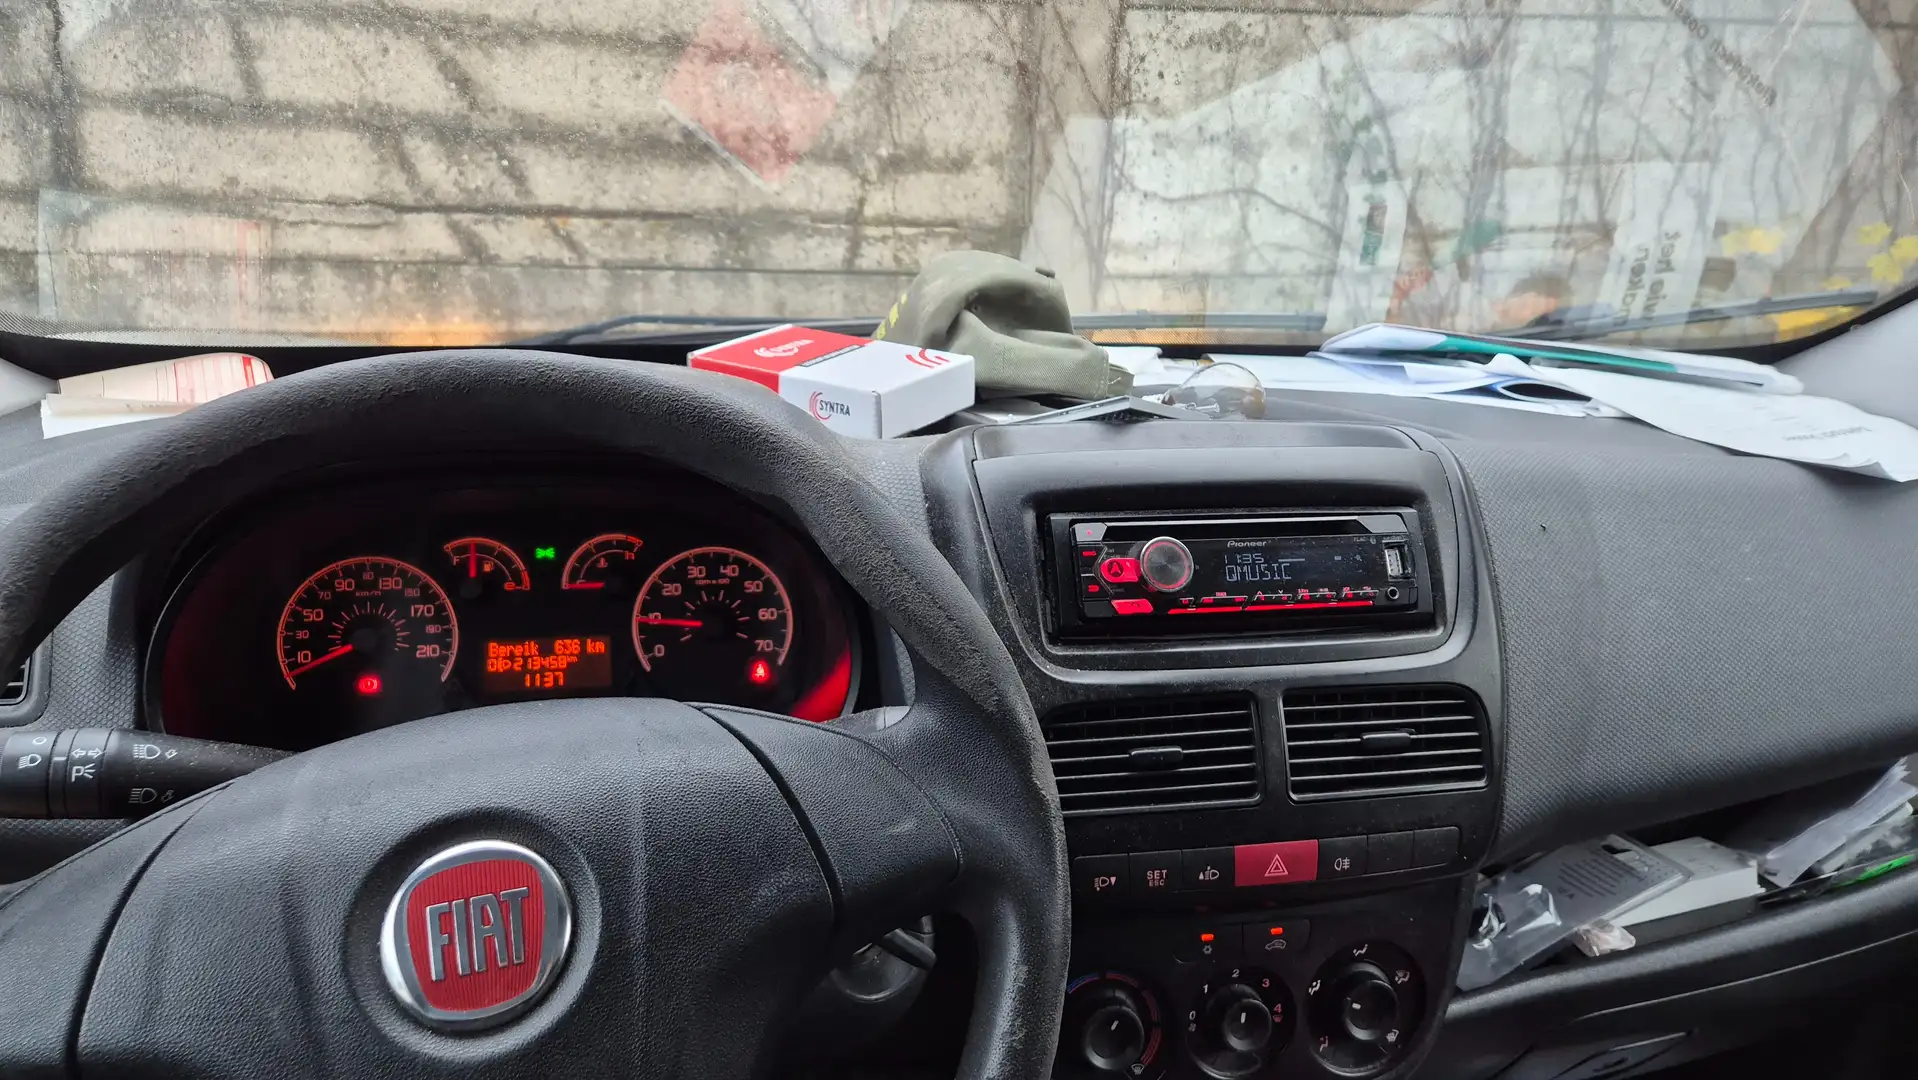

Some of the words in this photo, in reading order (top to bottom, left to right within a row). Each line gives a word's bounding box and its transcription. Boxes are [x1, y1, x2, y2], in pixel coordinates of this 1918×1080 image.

[819, 399, 851, 417] SYNTRA
[1227, 540, 1267, 548] Pioneer
[687, 566, 706, 578] 30
[720, 565, 739, 577] 40
[1225, 563, 1292, 582] QMUSIC
[335, 579, 356, 591] 90
[379, 577, 403, 590] 130
[662, 583, 682, 596] 20
[744, 580, 763, 593] 50
[320, 591, 332, 600] 70
[303, 609, 324, 622] 50
[411, 604, 435, 617] 170
[758, 608, 778, 620] 60
[296, 630, 309, 639] 30
[426, 625, 442, 634] 190
[416, 645, 440, 658] 210
[487, 641, 539, 657] Bereik
[586, 639, 605, 653] km
[654, 644, 665, 657] 0
[754, 639, 774, 652] 70
[297, 650, 311, 664] 10
[1146, 870, 1167, 880] SET
[1148, 879, 1165, 887] ESC
[425, 886, 529, 983] FIAT
[1231, 969, 1240, 978] 2
[1203, 984, 1209, 994] 1
[1262, 978, 1270, 988] 3
[1274, 1003, 1282, 1013] 4
[1188, 1010, 1196, 1021] 0
